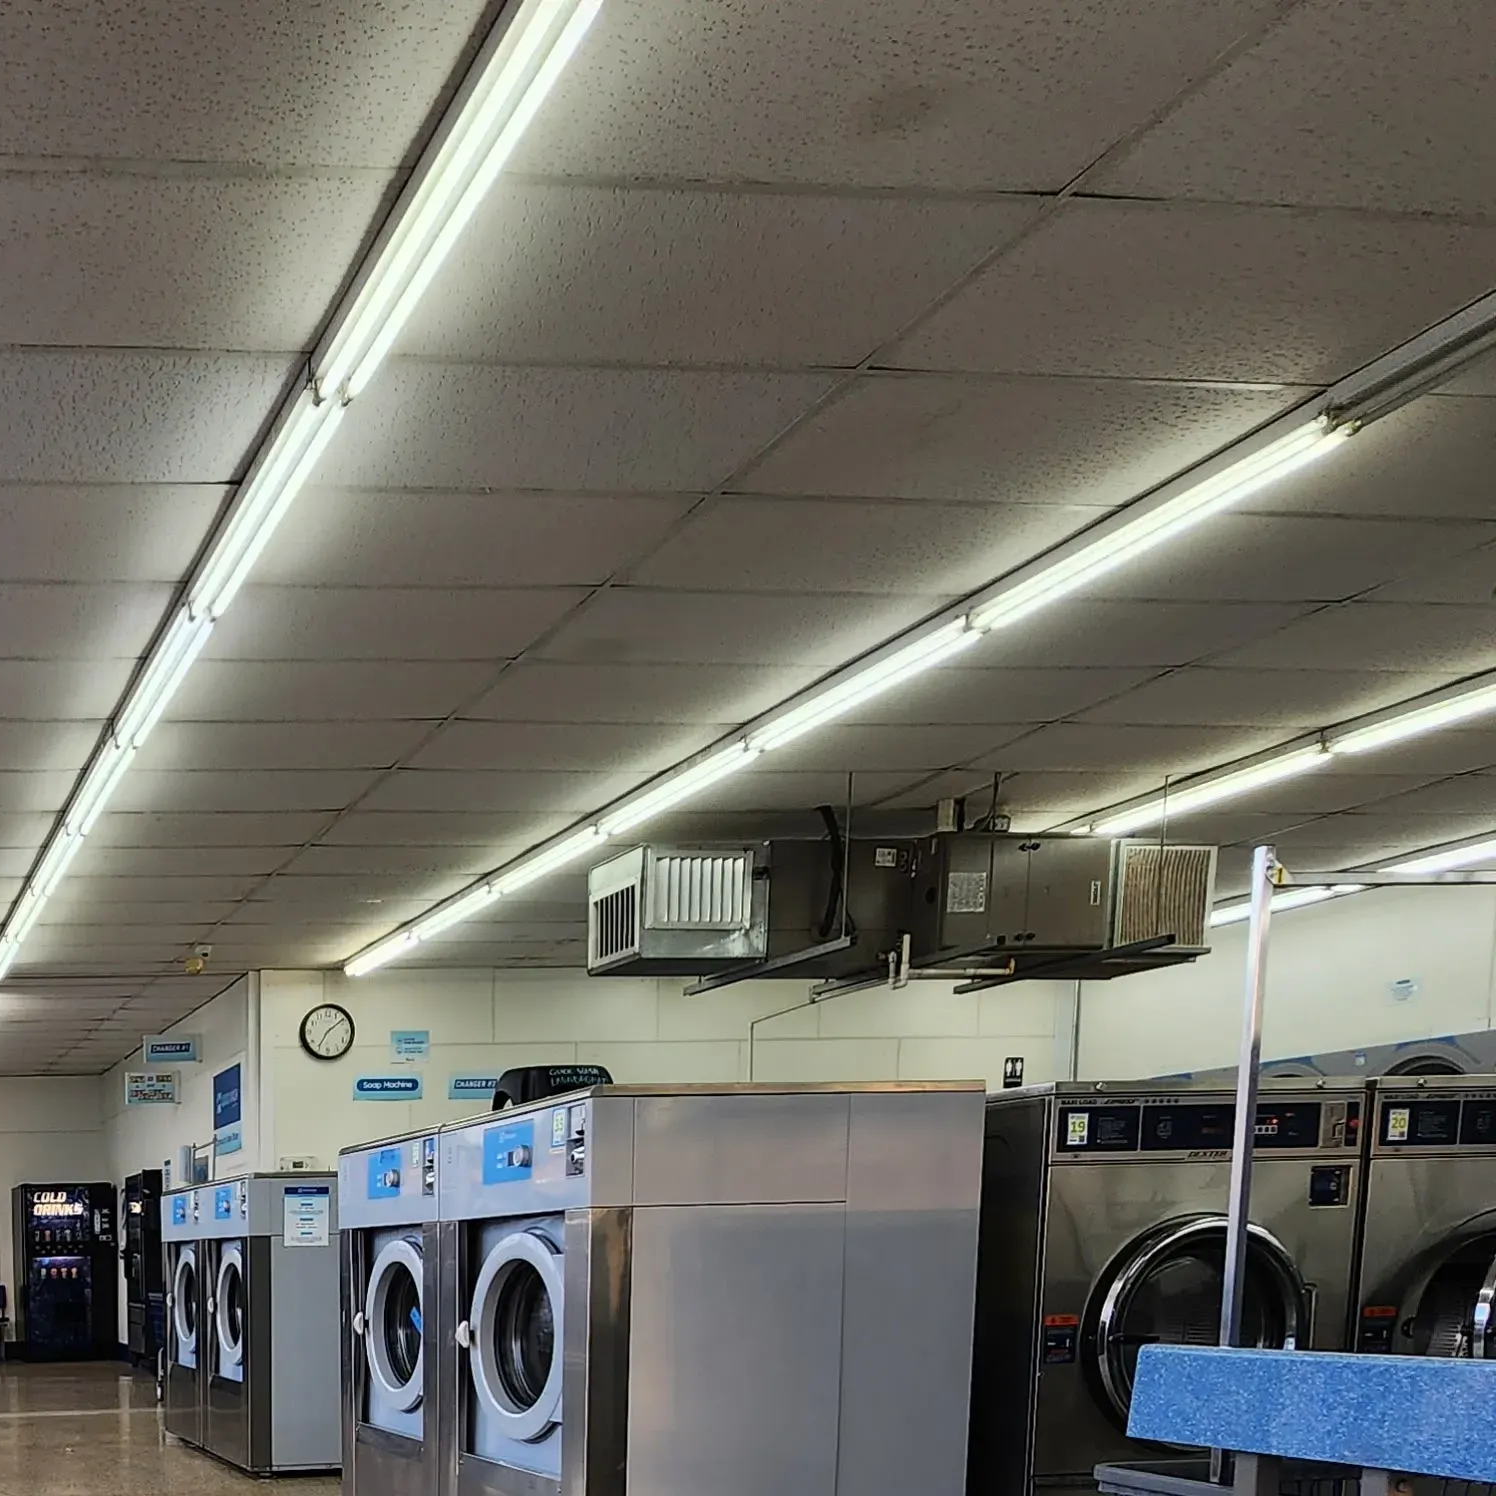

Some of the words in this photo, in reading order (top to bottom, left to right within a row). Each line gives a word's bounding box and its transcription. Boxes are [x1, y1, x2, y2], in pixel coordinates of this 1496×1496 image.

[152, 1044, 180, 1053] CHANGER
[362, 1081, 381, 1090] Soap
[383, 1080, 413, 1089] Machine
[455, 1080, 486, 1088] CHANGER
[1070, 1120, 1086, 1134] 19
[1391, 1117, 1406, 1129] 20
[1187, 1150, 1228, 1158] DEXTER
[33, 1191, 67, 1203] COLD
[33, 1202, 84, 1216] DRINKS
